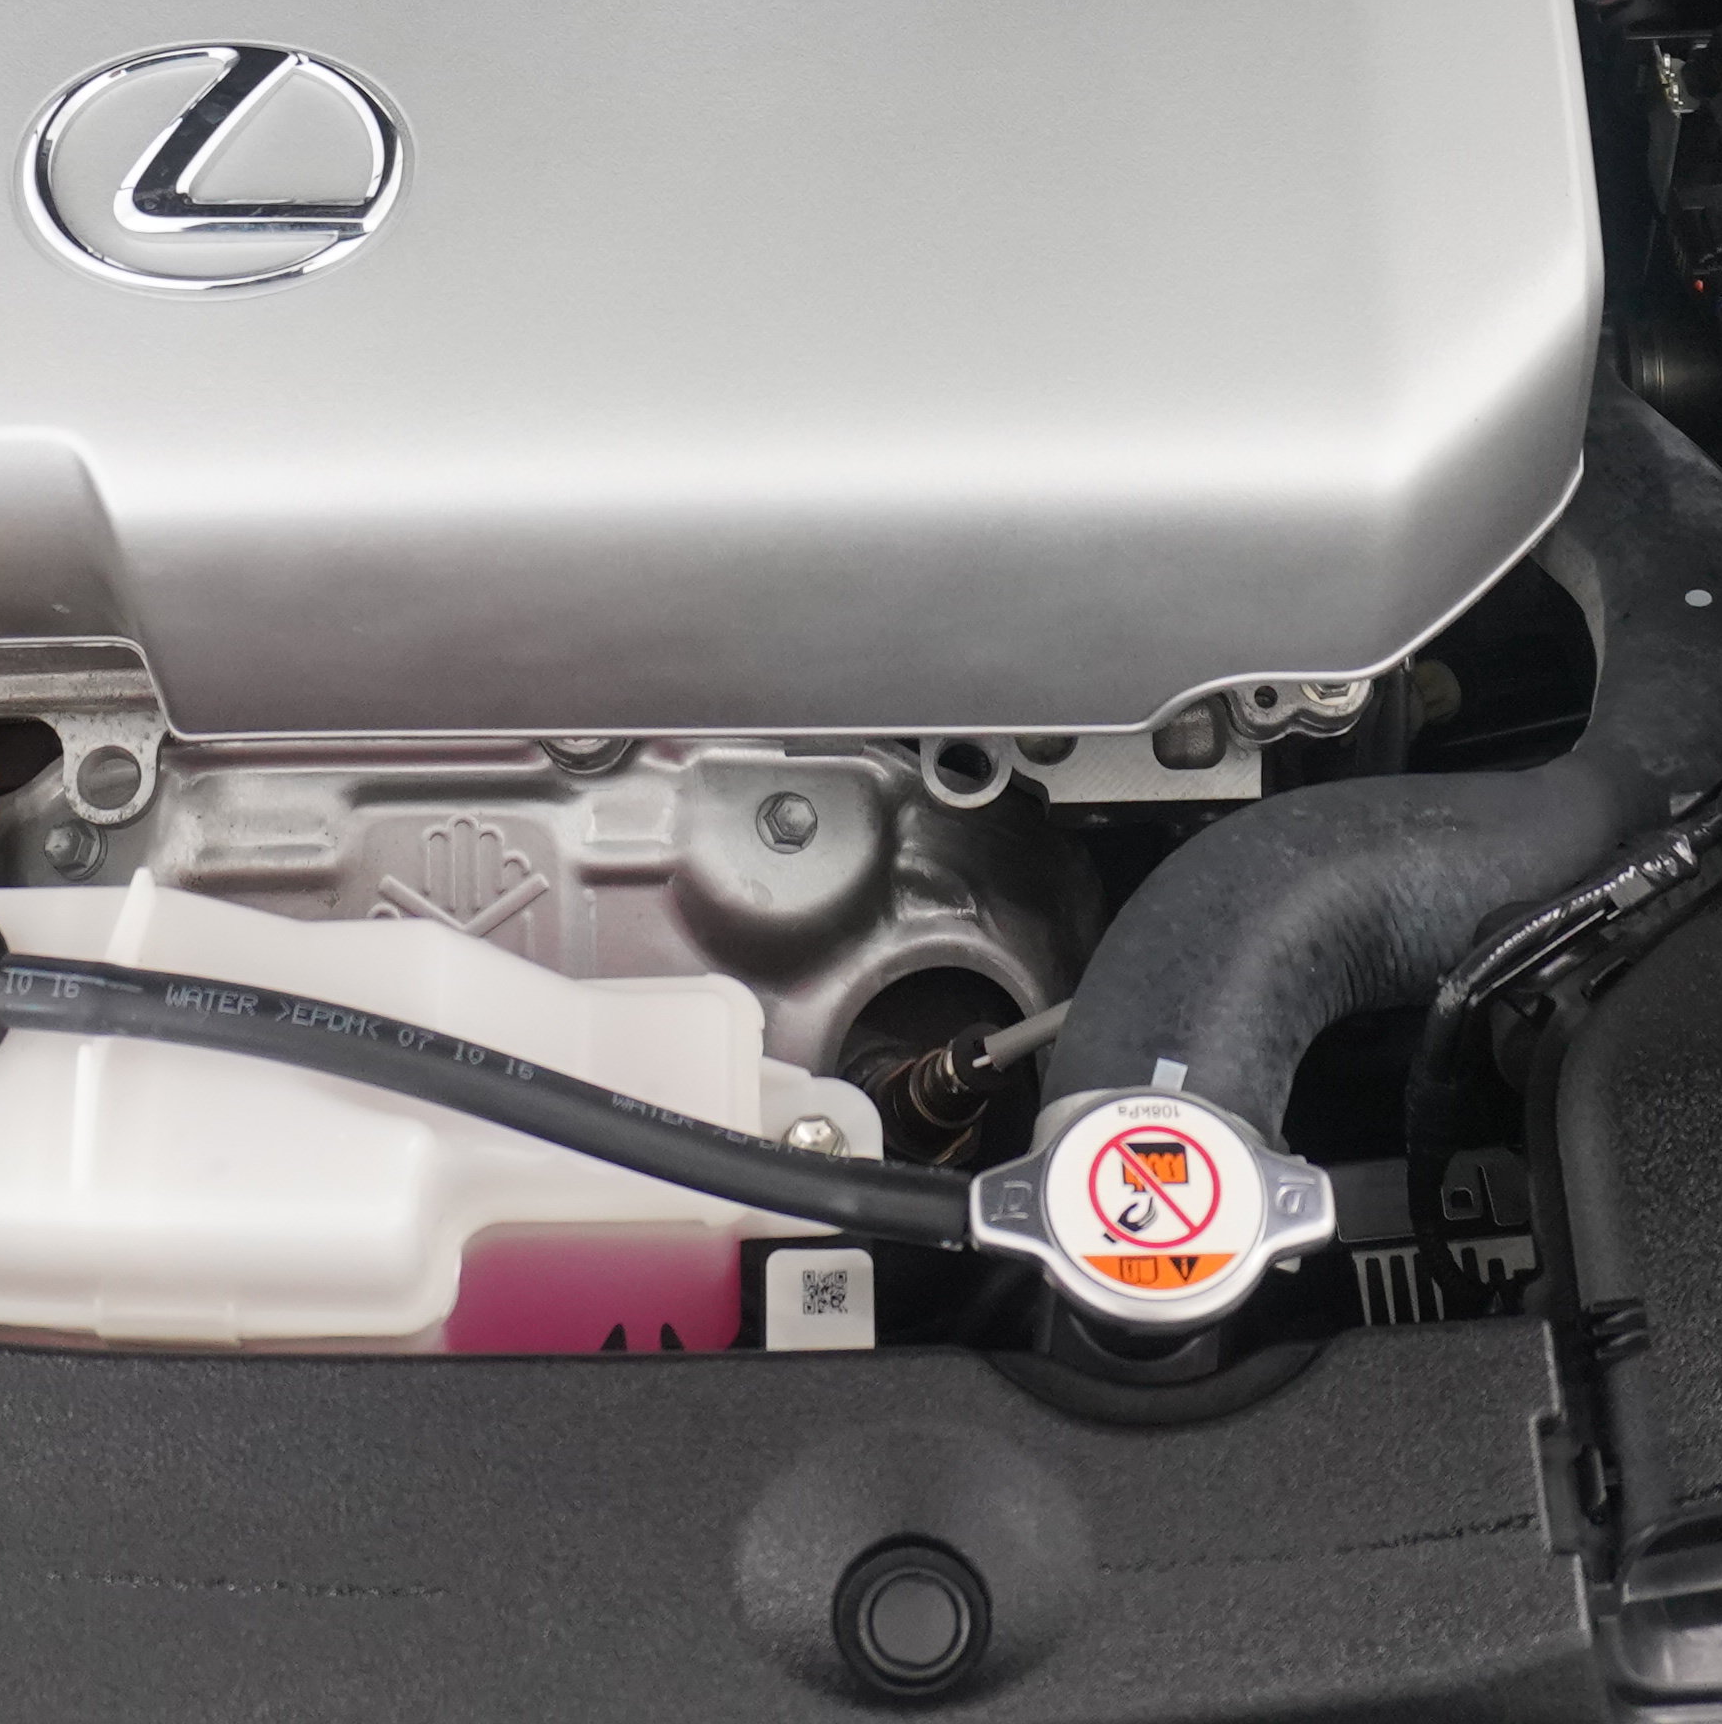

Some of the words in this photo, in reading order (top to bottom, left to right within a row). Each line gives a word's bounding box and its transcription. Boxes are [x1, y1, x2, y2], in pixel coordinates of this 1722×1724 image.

[164, 980, 259, 1018] WATER
[398, 1027, 435, 1053] 07
[1116, 1104, 1182, 1119] 108kPa
